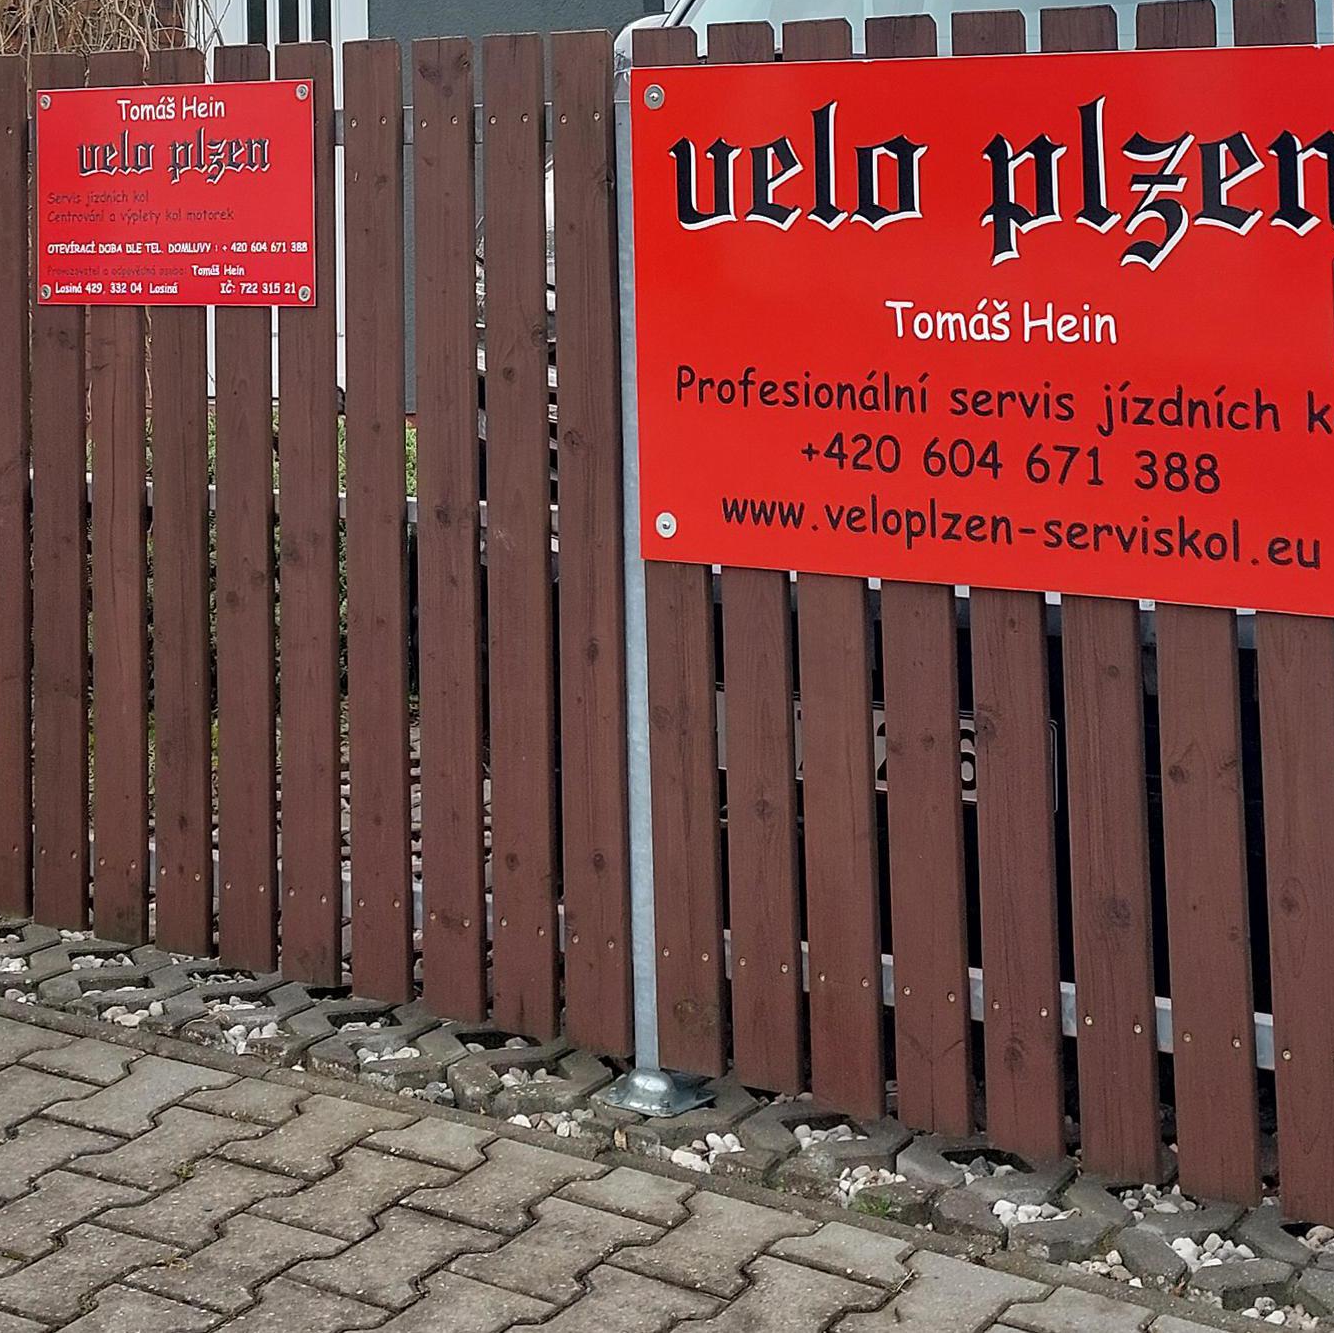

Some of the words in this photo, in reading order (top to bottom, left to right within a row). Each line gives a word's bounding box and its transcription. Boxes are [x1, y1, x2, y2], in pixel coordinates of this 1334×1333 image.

[117, 96, 175, 121] Tomáš
[182, 96, 225, 120] Hein
[77, 129, 155, 177] velo
[168, 126, 271, 184] plzen
[667, 98, 929, 231] velo
[47, 192, 81, 204] Servis
[133, 191, 149, 203] kol
[166, 209, 182, 221] kol
[186, 209, 234, 220] motorek
[47, 240, 96, 253] OTEVÍRACÍ
[98, 243, 123, 253] DOBA
[125, 243, 143, 253] DLE
[144, 242, 164, 253] TEL.
[168, 242, 211, 253] DOMLUVY
[230, 242, 248, 252] 420
[250, 242, 268, 252] 604
[271, 242, 287, 252] 671
[290, 242, 308, 252] 388
[109, 282, 127, 294] 332
[131, 282, 143, 294] 04
[239, 282, 258, 294] 722
[284, 282, 297, 294] 21
[191, 265, 219, 276] Tomáš
[223, 265, 245, 276] Hein
[884, 298, 1011, 342] Tomáš
[1023, 300, 1117, 344] Hein
[676, 364, 929, 414] Profesionální
[949, 381, 1075, 421] servis
[1096, 380, 1281, 438] jízdních
[801, 432, 902, 474] +420
[923, 437, 1004, 480] 604
[1025, 442, 1104, 486] 671
[1134, 449, 1221, 495] 388
[721, 494, 1321, 570] www.veloplzen-serviskol.eu
